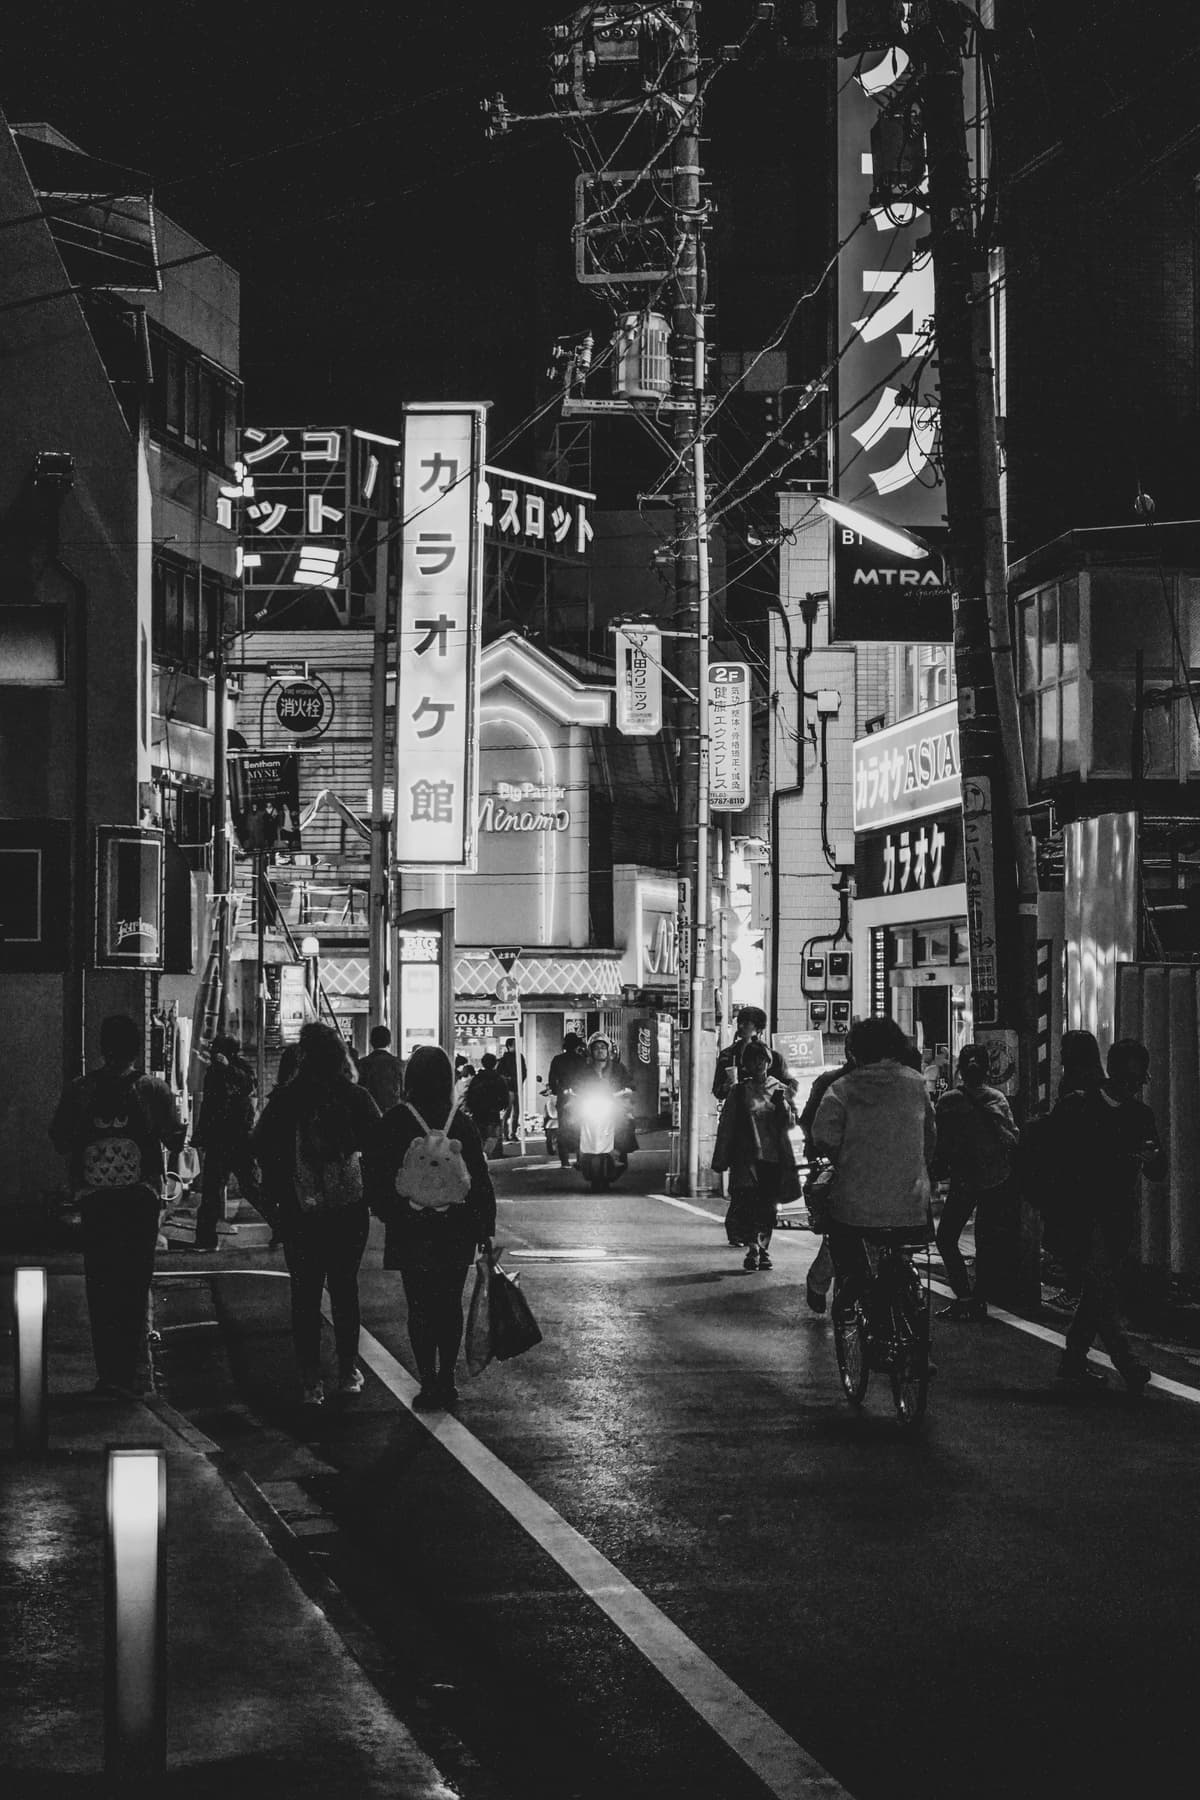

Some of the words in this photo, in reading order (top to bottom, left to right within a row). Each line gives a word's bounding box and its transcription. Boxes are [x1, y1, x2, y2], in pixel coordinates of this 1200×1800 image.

[410, 452, 458, 824] カラオケ館
[280, 698, 321, 718] 消火栓
[714, 667, 739, 682] 2F
[857, 747, 904, 812] カラオケ
[903, 730, 961, 794] ASIA
[882, 822, 946, 894] カラオケ
